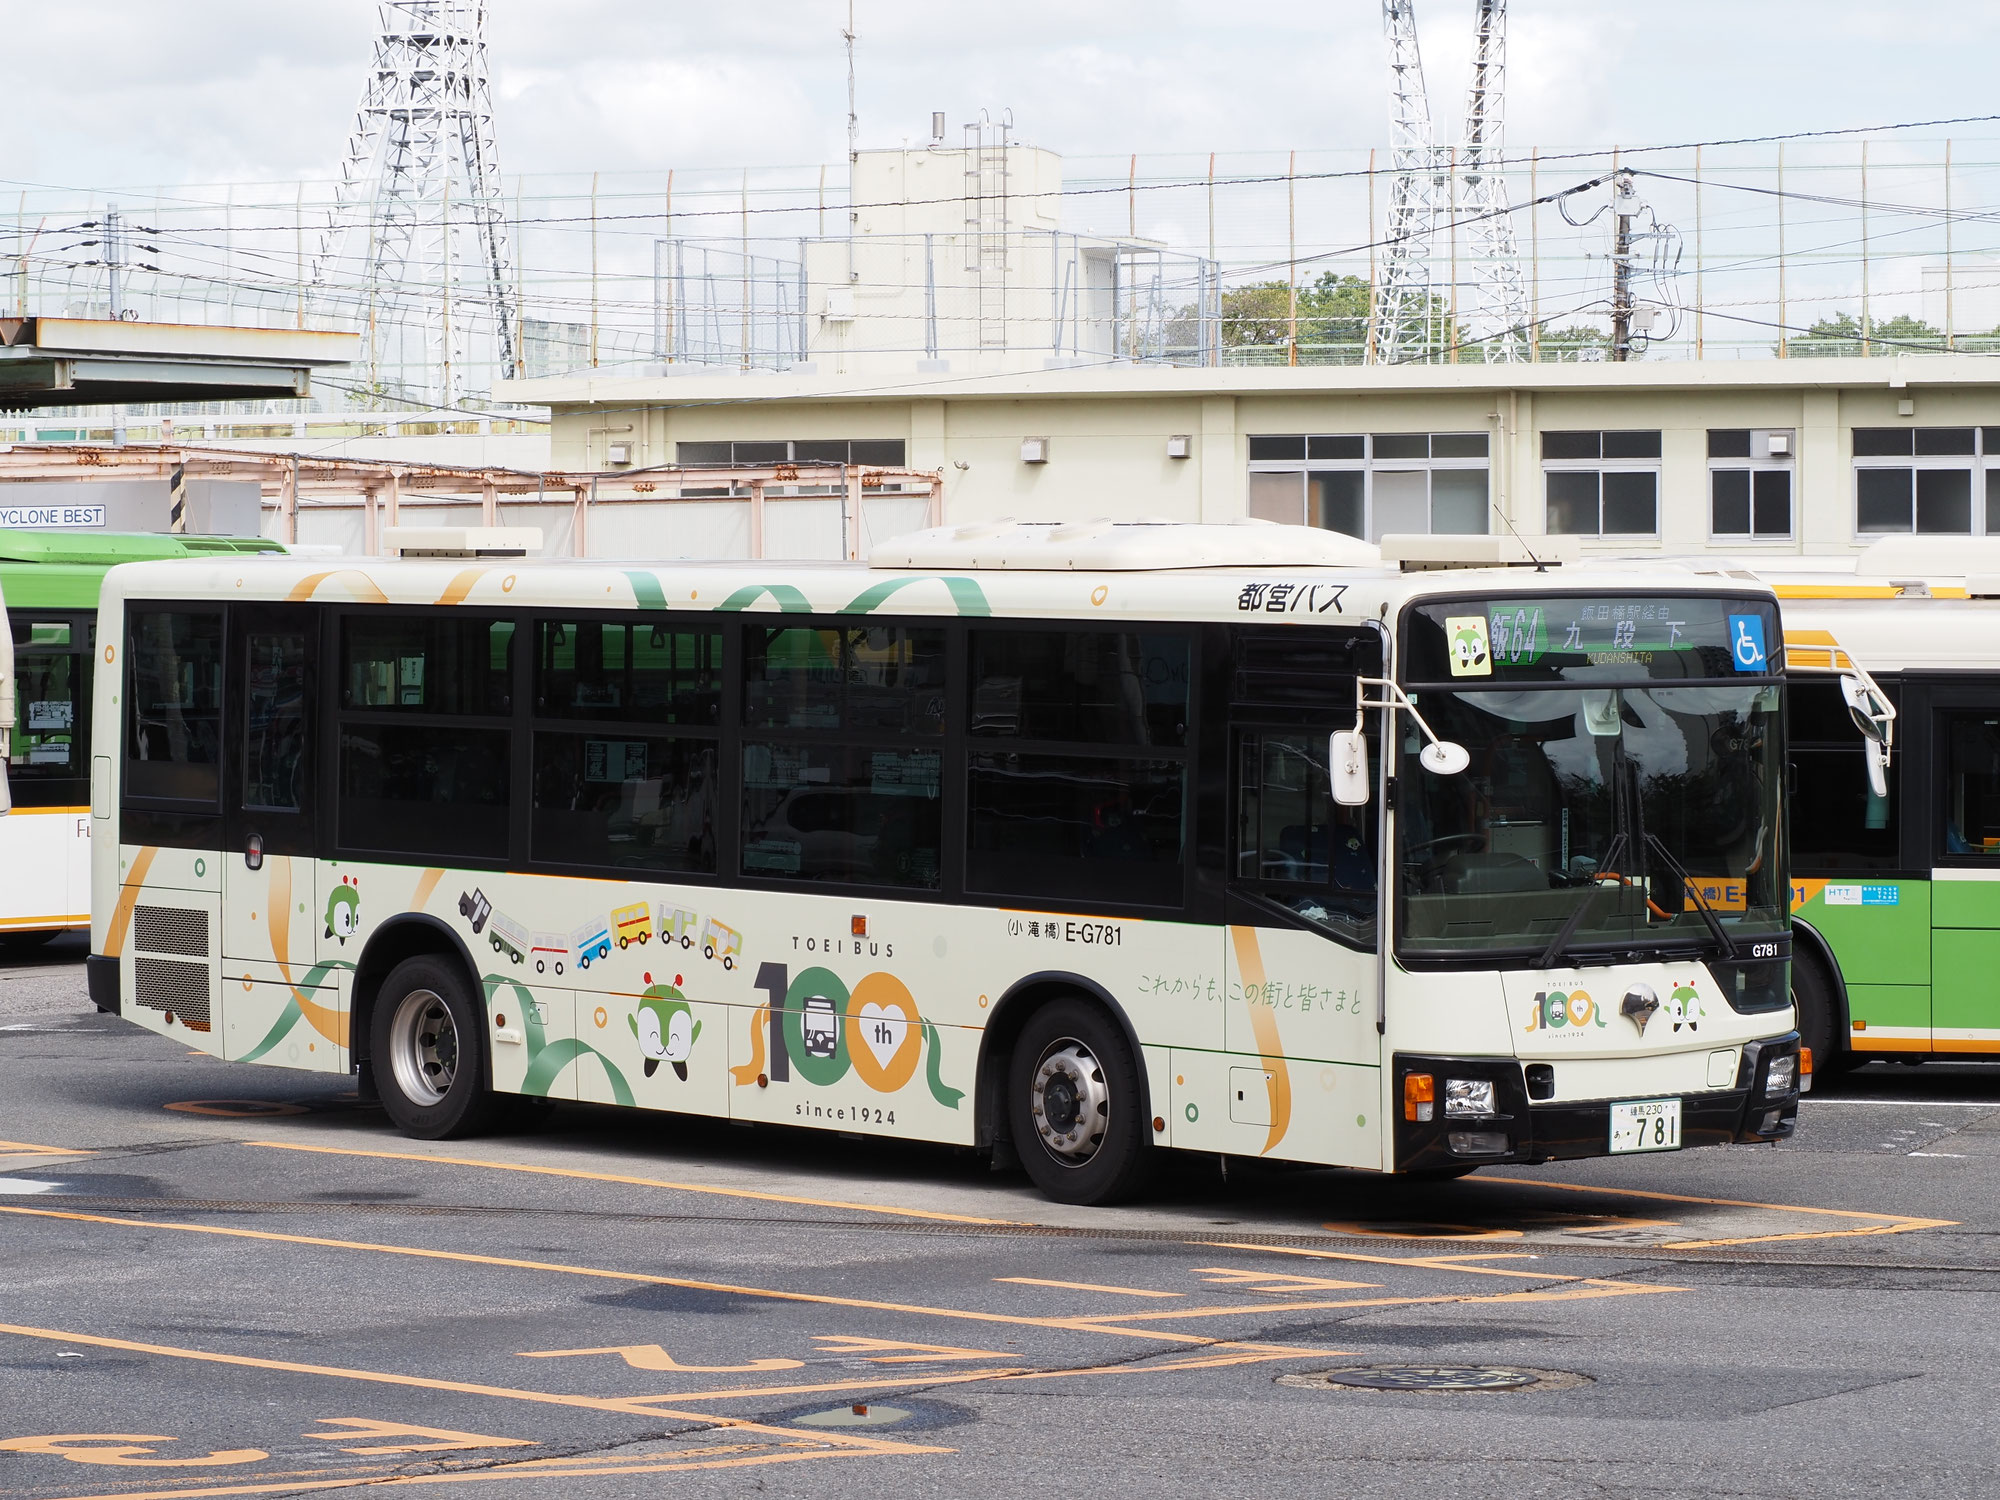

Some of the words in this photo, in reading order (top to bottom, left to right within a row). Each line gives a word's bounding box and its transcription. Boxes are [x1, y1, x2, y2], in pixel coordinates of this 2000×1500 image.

[0, 509, 58, 524] YCLONE
[64, 508, 102, 523] BEST
[1238, 582, 1349, 614] 都営バス
[1581, 605, 1670, 621] 飯田橋駅経由
[1562, 620, 1686, 650] 九段下
[1586, 652, 1653, 665] KUDANSHITA
[1007, 918, 1060, 940] (小滝橋)
[1066, 922, 1121, 946] E-G781
[792, 936, 842, 953] TOEI
[854, 941, 893, 958] BUS
[1752, 943, 1778, 958] G781
